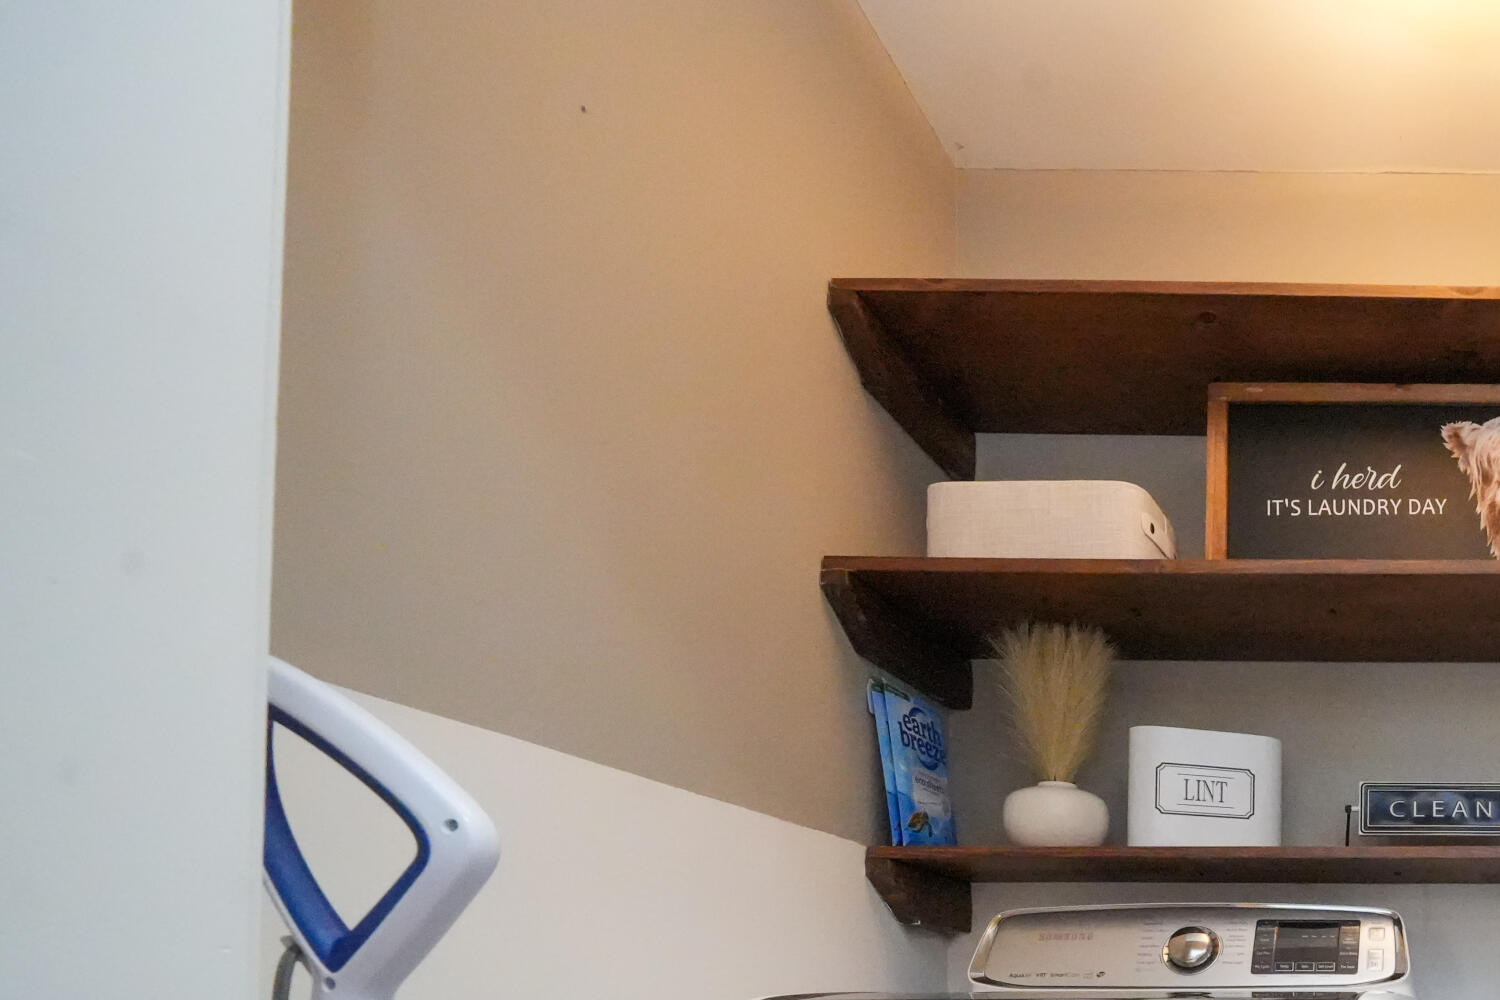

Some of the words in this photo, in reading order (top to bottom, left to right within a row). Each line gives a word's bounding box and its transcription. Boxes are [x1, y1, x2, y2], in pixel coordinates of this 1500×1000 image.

[1311, 469, 1324, 490] i
[1331, 462, 1402, 490] herd
[1266, 499, 1301, 516] IT'S
[1307, 499, 1402, 516] LAUNDRY
[1407, 499, 1447, 516] DAY
[898, 721, 947, 766] breeze
[903, 714, 941, 747] earth
[1183, 779, 1228, 803] LINT
[1389, 800, 1493, 818] CLEAN
